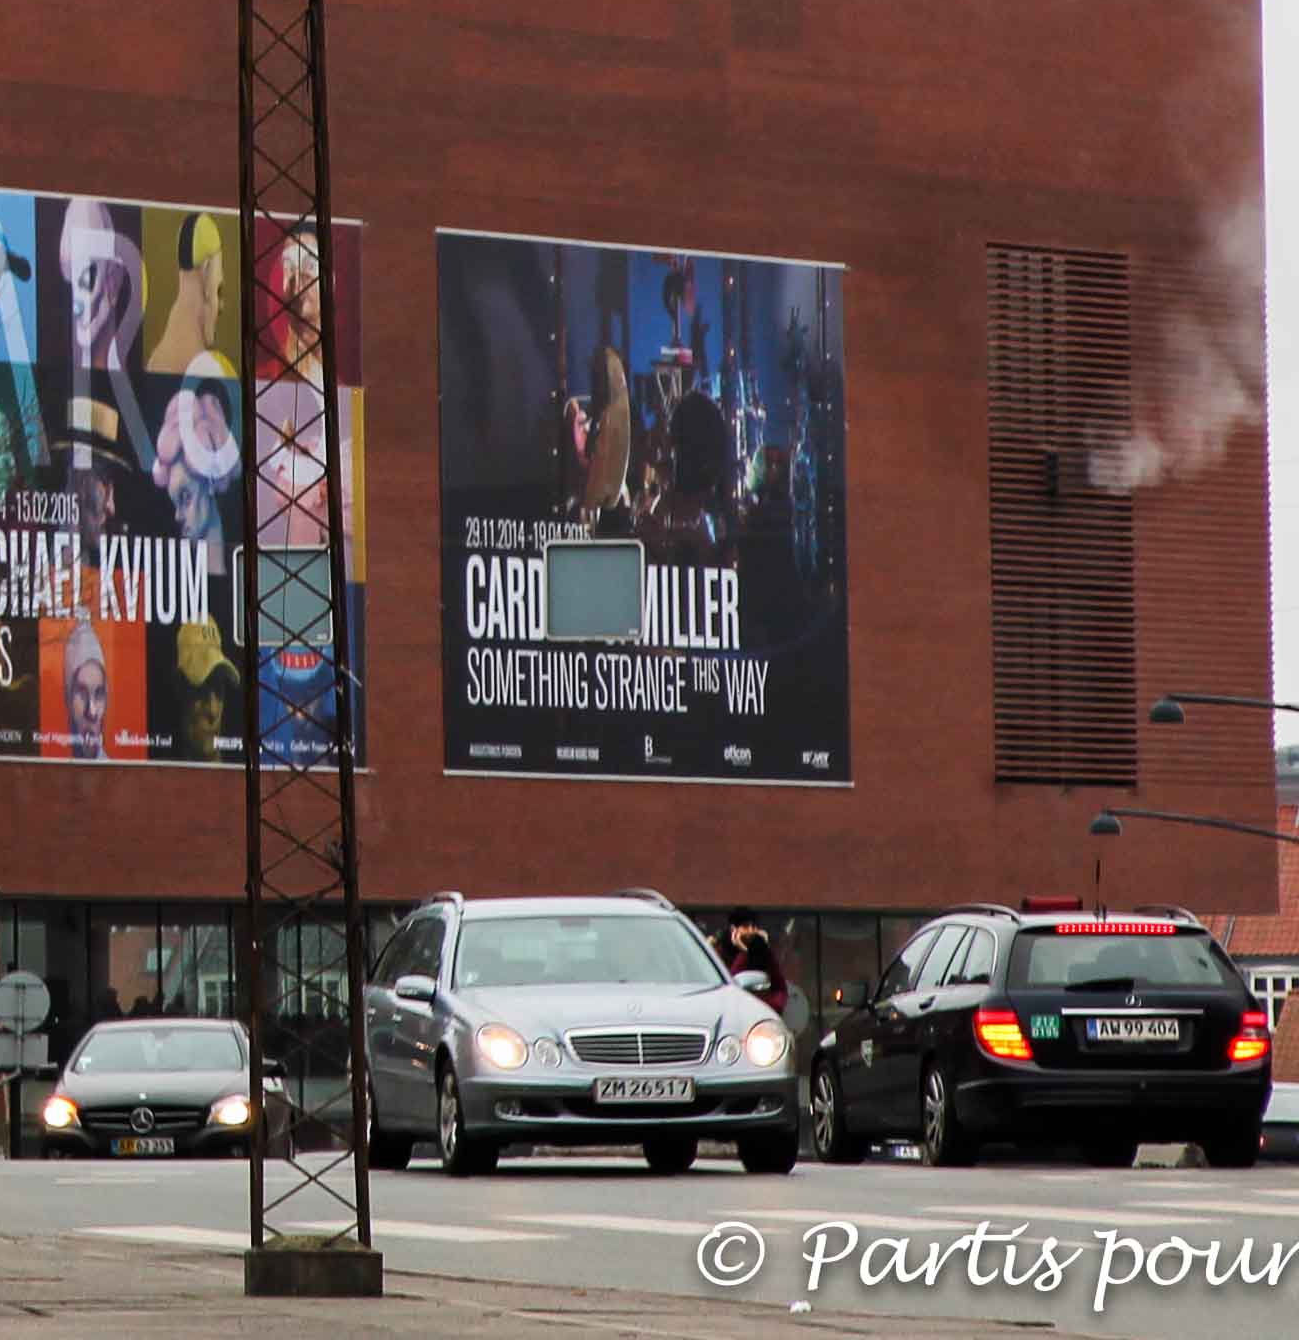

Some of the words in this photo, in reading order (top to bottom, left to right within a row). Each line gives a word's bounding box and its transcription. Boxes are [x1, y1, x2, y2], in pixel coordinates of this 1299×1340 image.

[100, 534, 209, 626] KVIUM
[466, 554, 545, 641] CARD
[467, 647, 589, 709] SOMETHING
[595, 652, 688, 713] STRANGE
[692, 657, 720, 694] THIS
[724, 660, 769, 716] WAY
